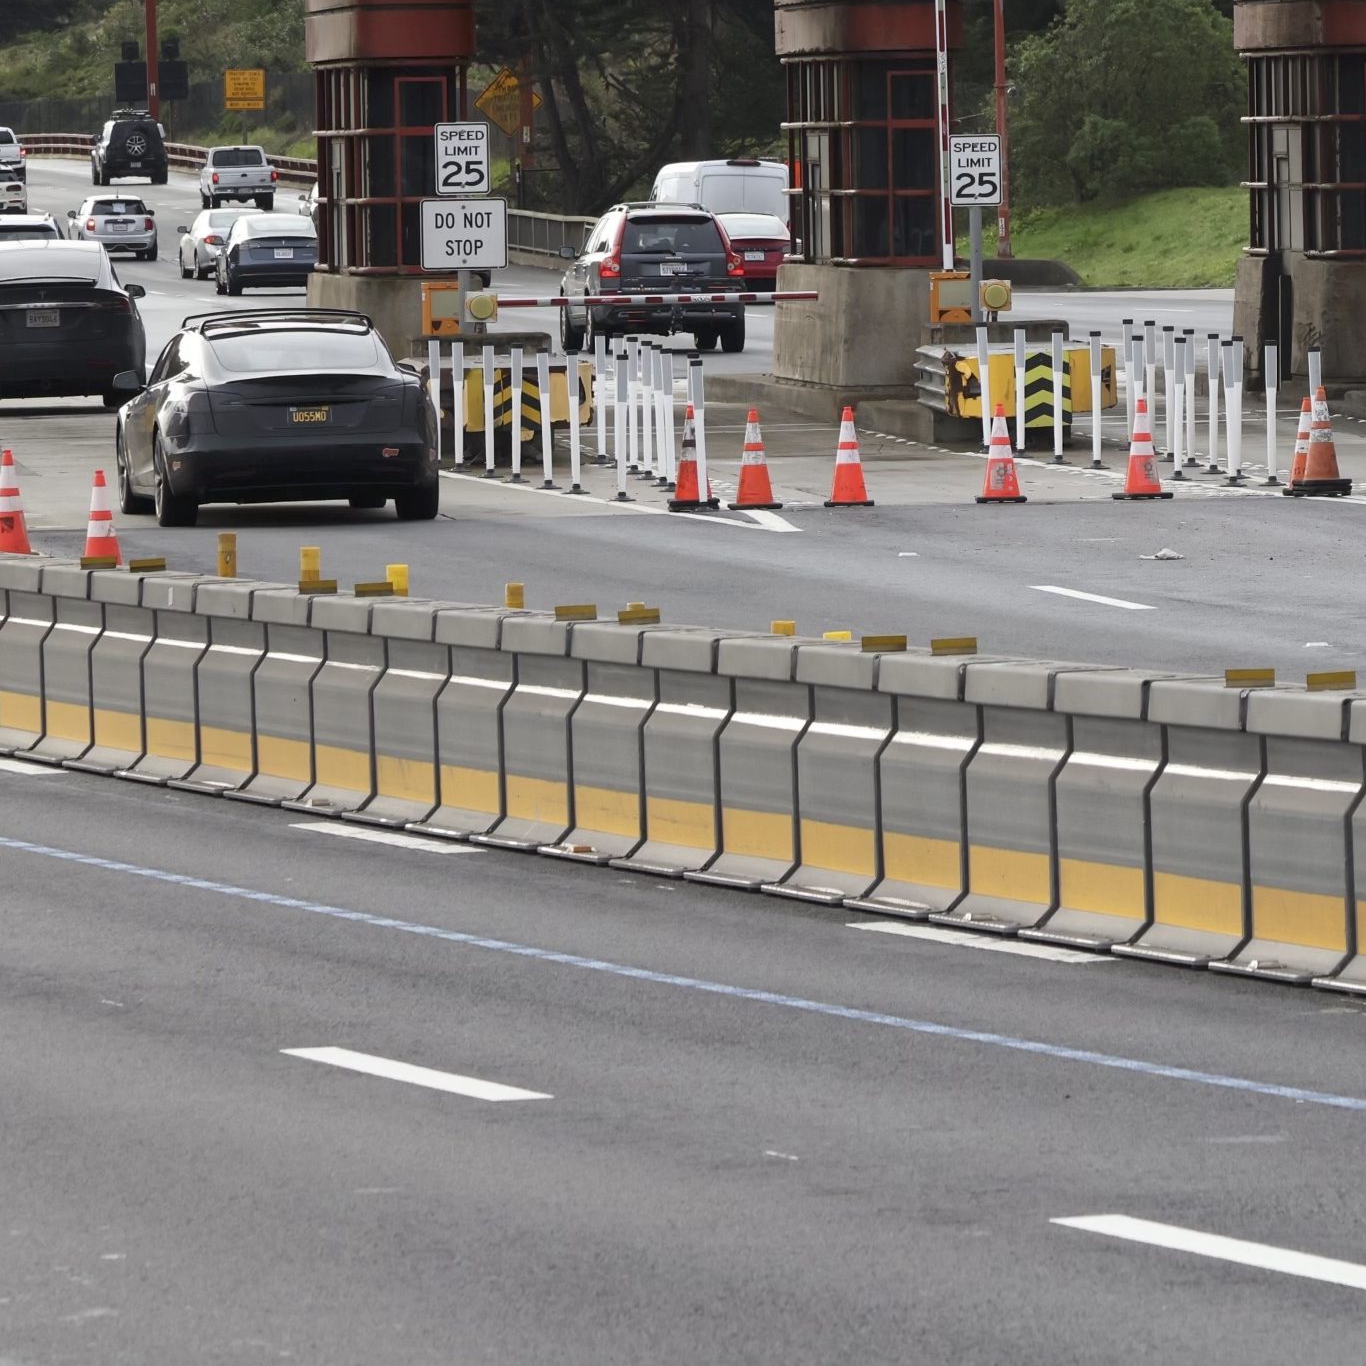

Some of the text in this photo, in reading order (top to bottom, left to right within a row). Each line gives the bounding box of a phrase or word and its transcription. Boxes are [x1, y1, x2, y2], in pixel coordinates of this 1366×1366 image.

[440, 130, 485, 141] SPEED
[444, 146, 480, 156] LIMIT
[953, 142, 998, 153] SPEED
[957, 157, 993, 168] LIMIT
[441, 160, 485, 187] 25
[955, 172, 998, 199] 25
[435, 212, 493, 229] DO NOT
[445, 239, 484, 256] STOP
